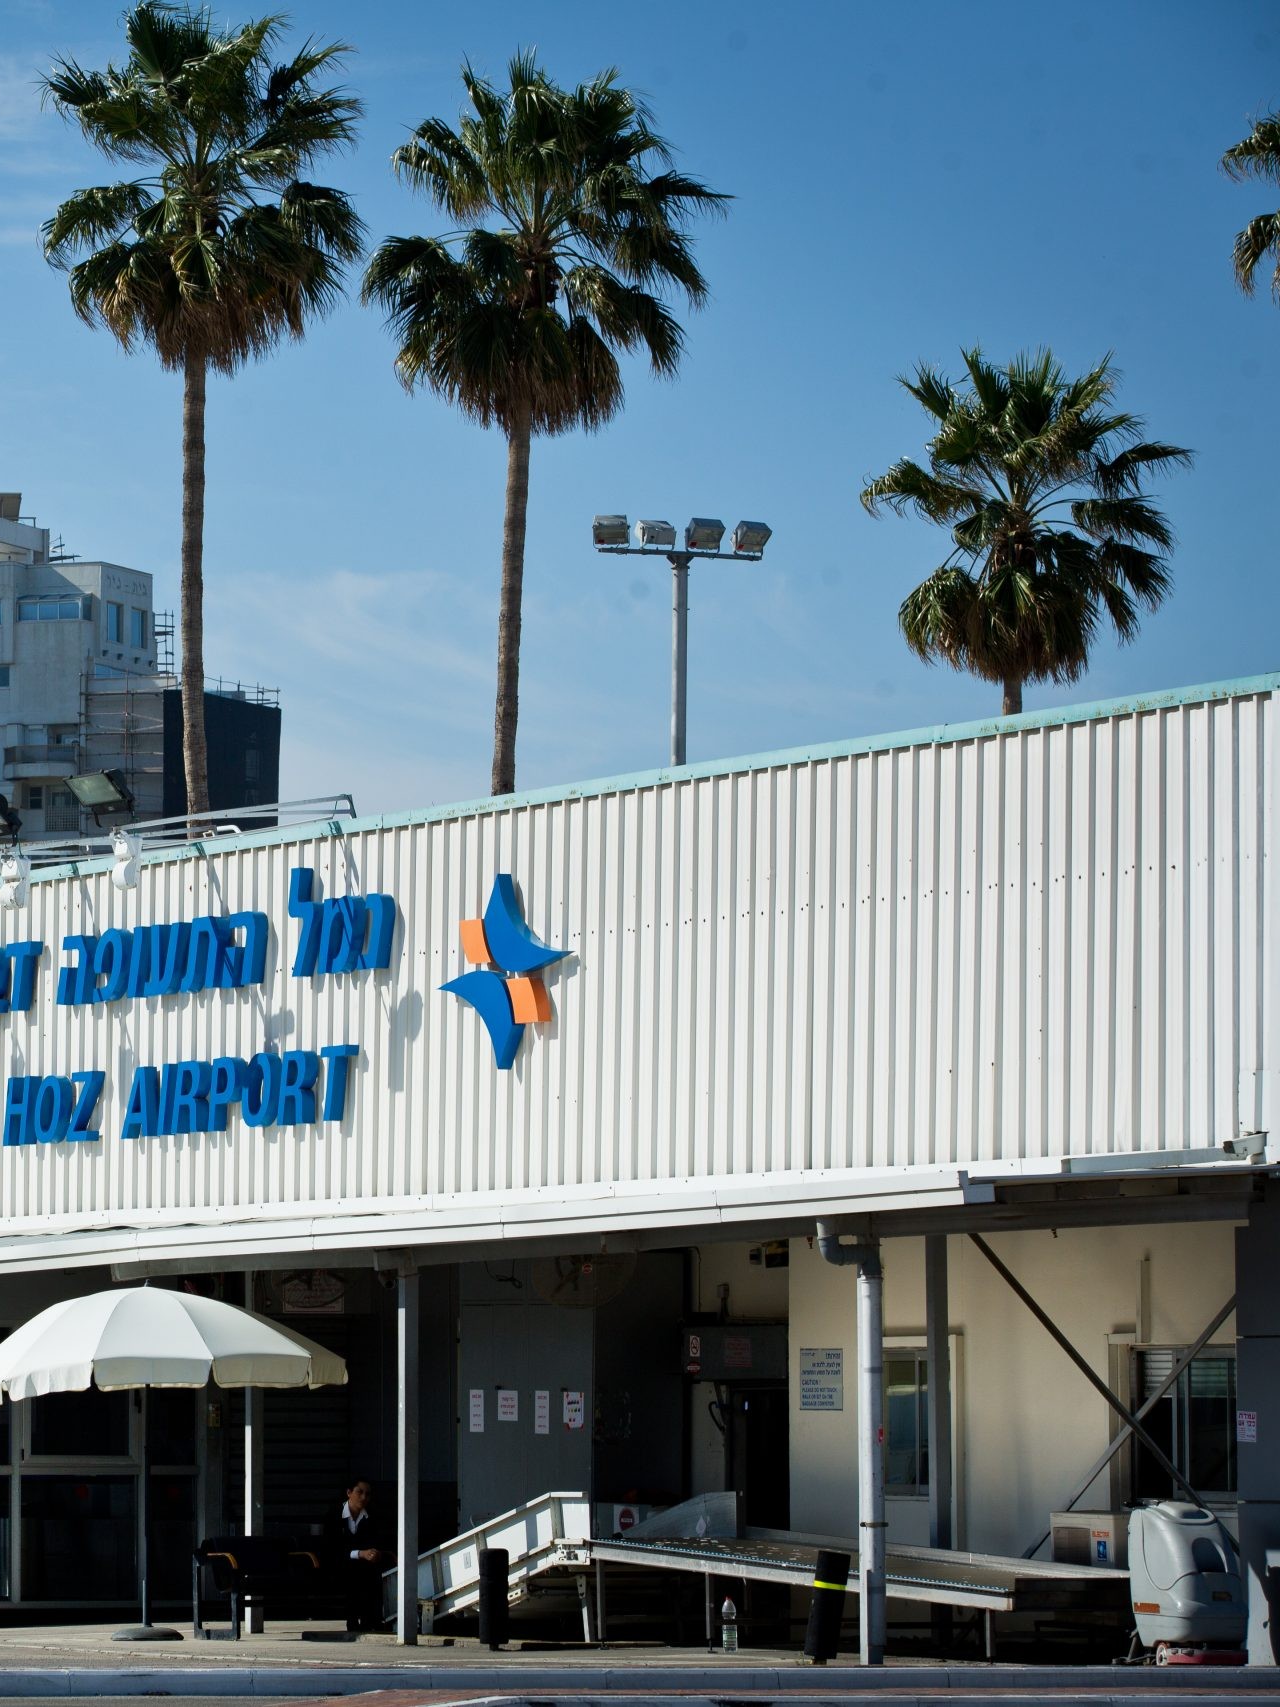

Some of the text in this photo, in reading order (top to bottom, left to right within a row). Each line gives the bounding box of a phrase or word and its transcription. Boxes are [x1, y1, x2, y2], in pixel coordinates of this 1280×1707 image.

[56, 911, 268, 1005] התעופה
[288, 867, 396, 977] נמל
[3, 1070, 106, 1147] HOZ
[121, 1044, 360, 1139] AIRPORT
